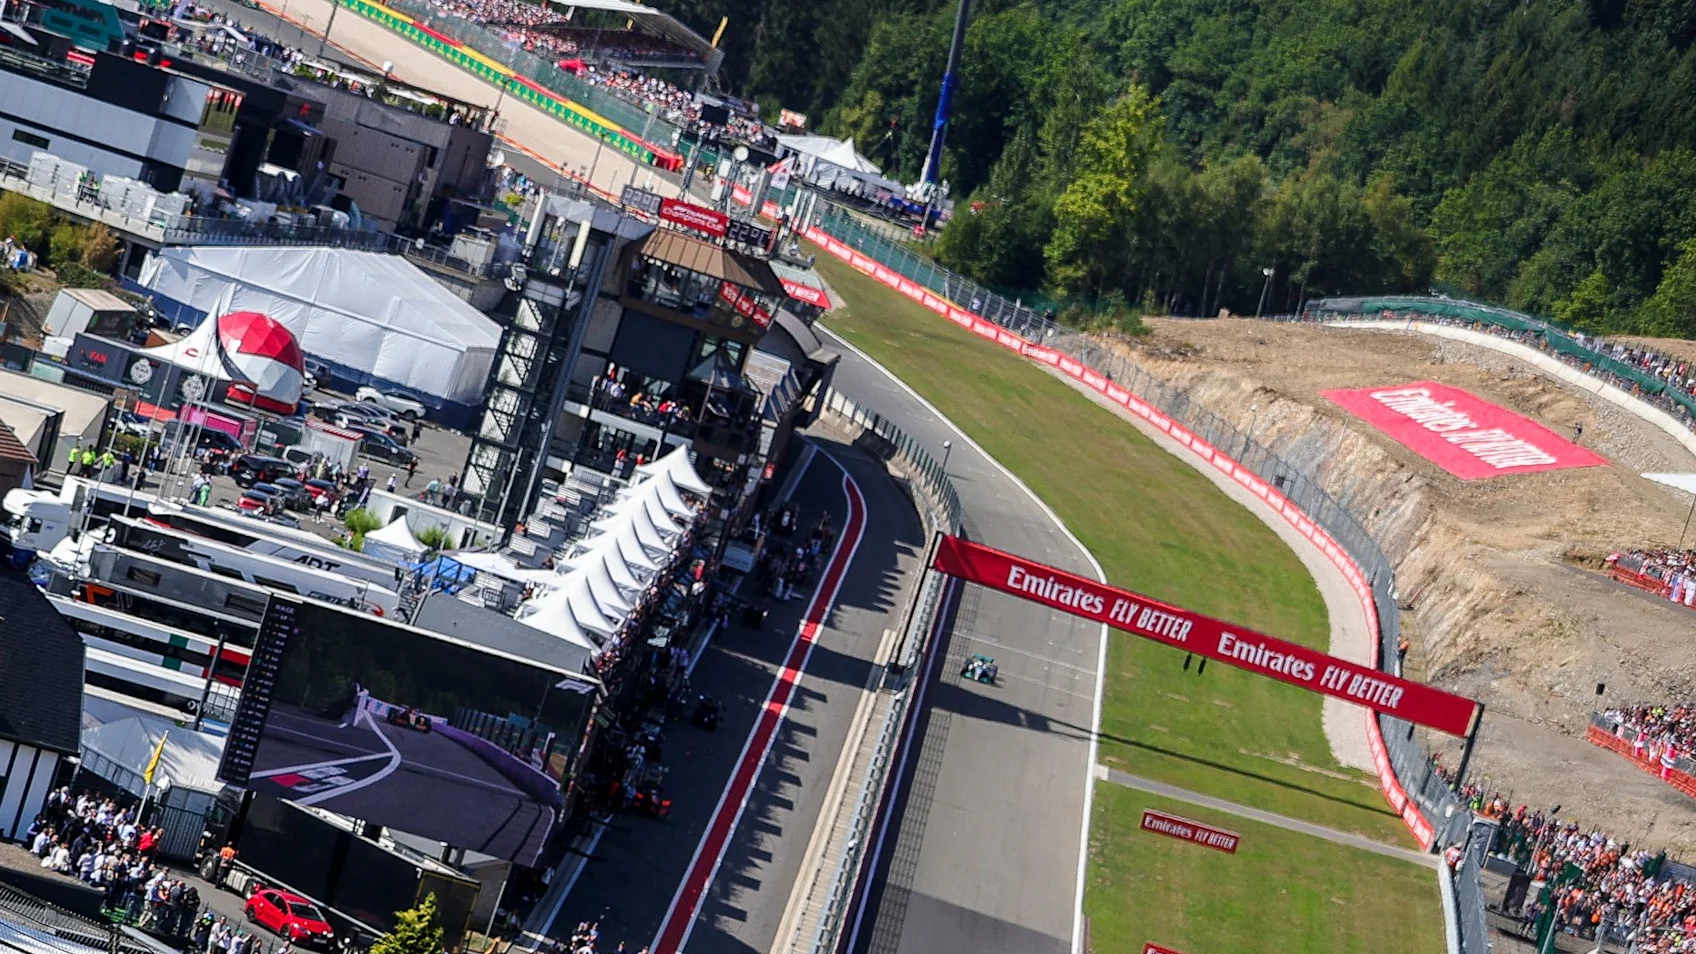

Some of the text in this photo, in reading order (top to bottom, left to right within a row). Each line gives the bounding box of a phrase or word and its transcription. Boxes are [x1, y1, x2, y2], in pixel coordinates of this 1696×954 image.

[1007, 565, 1104, 614] Emirates
[1109, 598, 1140, 624] FLY
[1137, 607, 1193, 642] BETTER
[1217, 631, 1315, 681] Emirates
[1319, 665, 1351, 691] FLY
[1347, 673, 1404, 709] BETTER
[1144, 815, 1192, 838] Emirates
